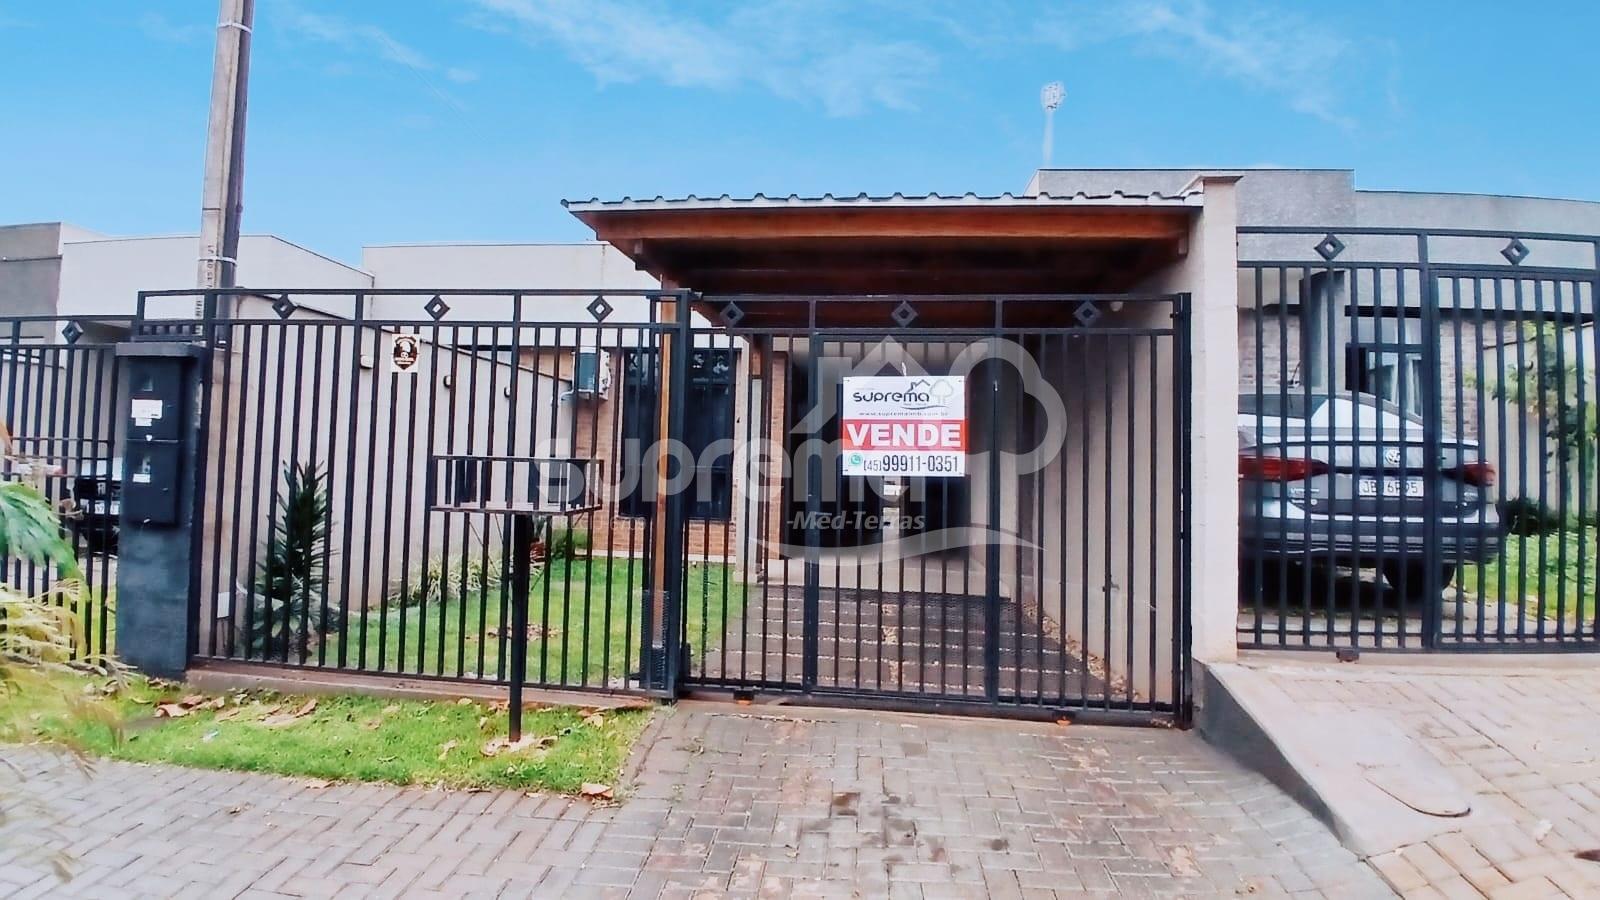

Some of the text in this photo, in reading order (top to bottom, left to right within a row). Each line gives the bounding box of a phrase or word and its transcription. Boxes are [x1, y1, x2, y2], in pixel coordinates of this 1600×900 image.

[853, 392, 930, 403] suprema
[846, 423, 961, 447] VENDE
[863, 454, 958, 472] (45)99911-0351
